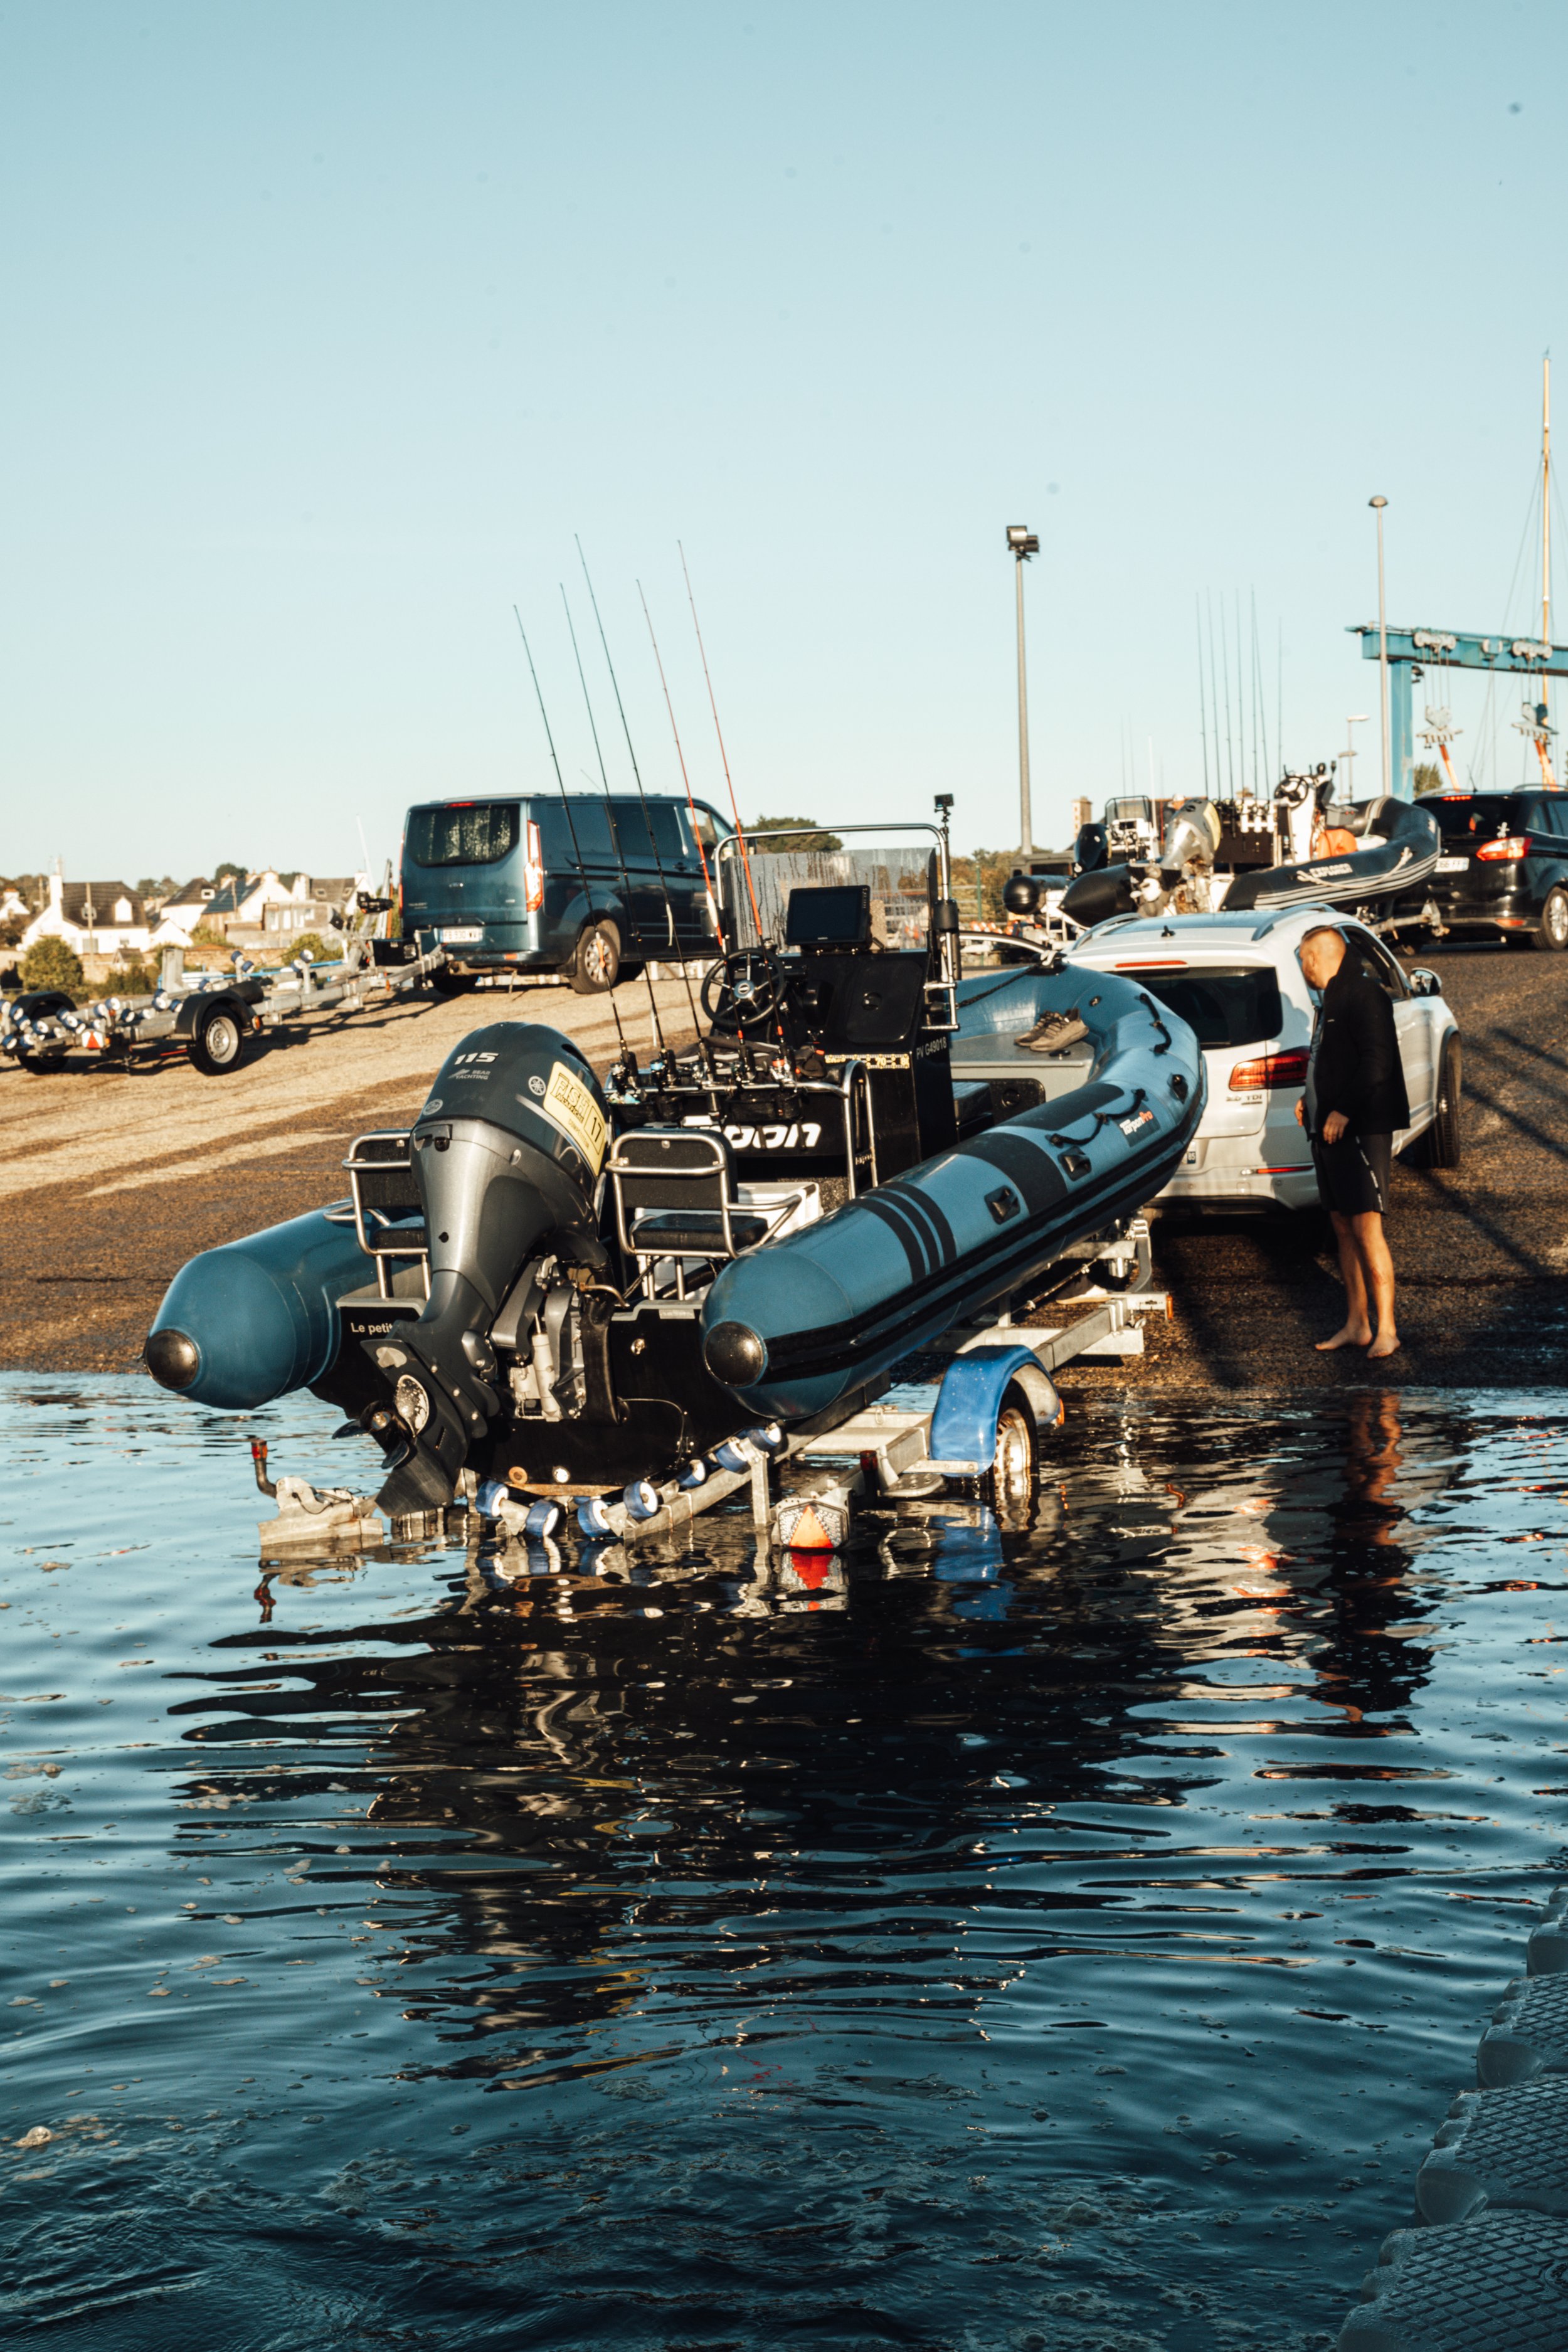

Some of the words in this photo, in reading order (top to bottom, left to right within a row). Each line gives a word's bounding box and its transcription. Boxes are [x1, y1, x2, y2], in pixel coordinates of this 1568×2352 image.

[454, 1052, 499, 1065] 115
[551, 1073, 590, 1116] FISH
[591, 1117, 601, 1142] 17
[351, 1322, 365, 1333] Le
